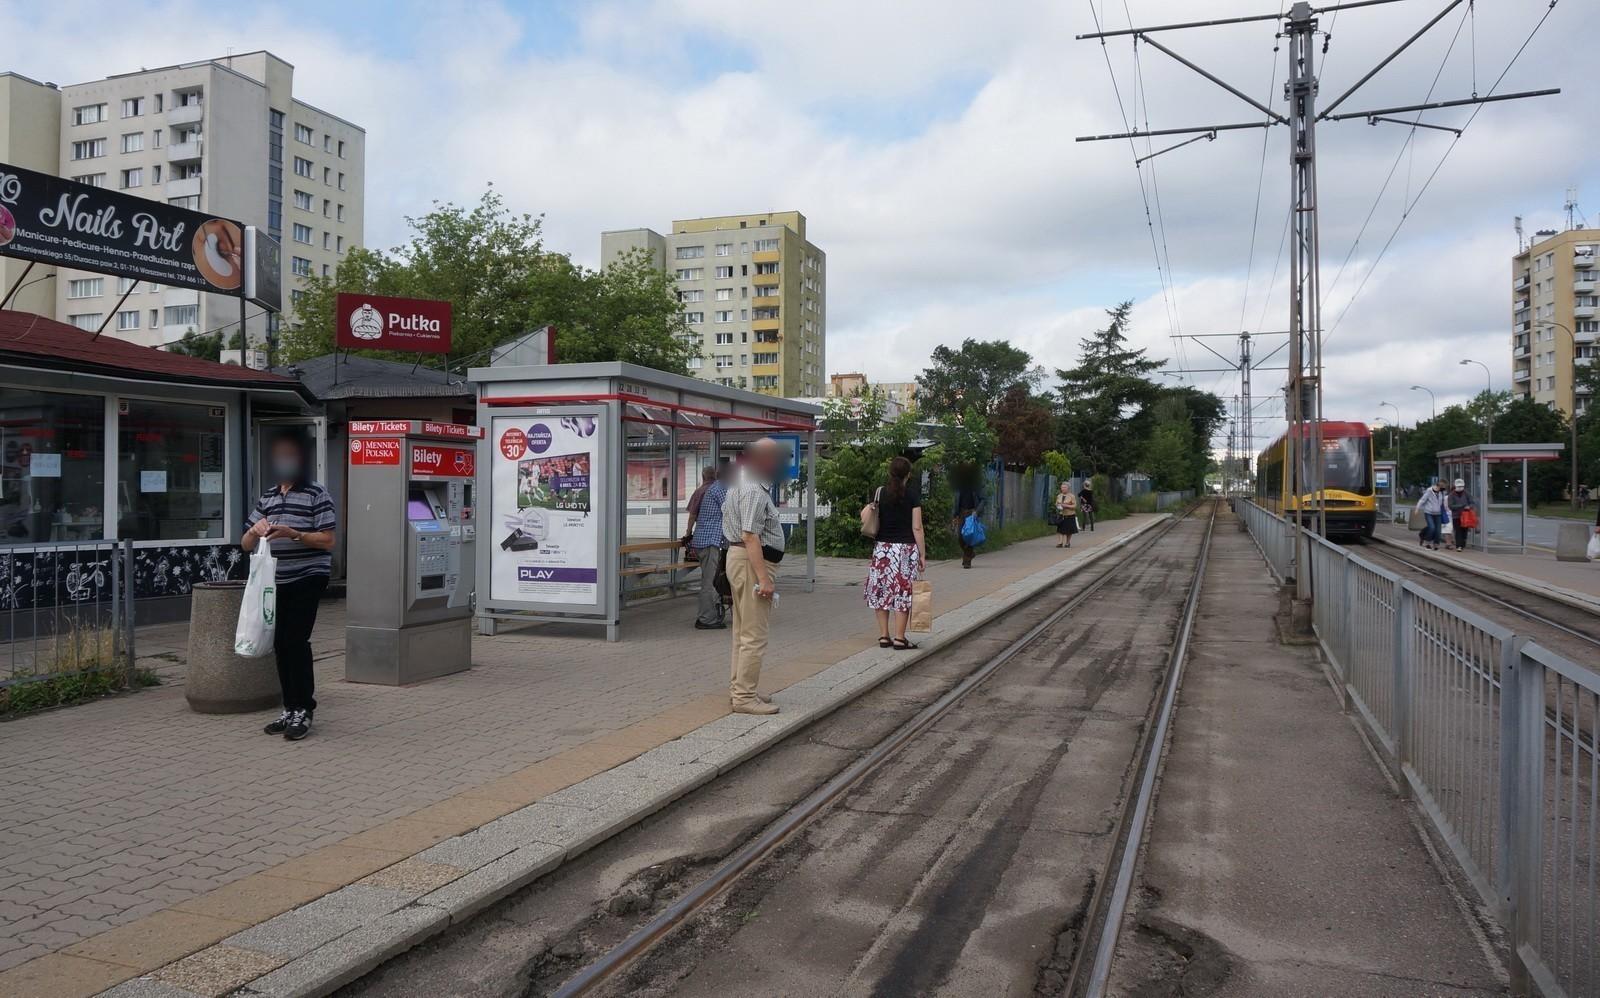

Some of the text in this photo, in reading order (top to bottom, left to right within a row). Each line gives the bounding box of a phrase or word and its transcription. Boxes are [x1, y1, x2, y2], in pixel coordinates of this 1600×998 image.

[39, 193, 185, 252] Nails Art
[181, 261, 196, 271] rzęs
[388, 313, 440, 332] Putka
[352, 422, 375, 433] Bilety
[380, 422, 407, 431] Tickets
[425, 423, 443, 435] Bilety
[446, 425, 465, 435] Tickets
[366, 441, 399, 449] MENNICA
[506, 444, 519, 457] 30
[366, 449, 394, 457] POLSKA
[413, 449, 442, 466] Bilety
[520, 569, 554, 579] PLAY
